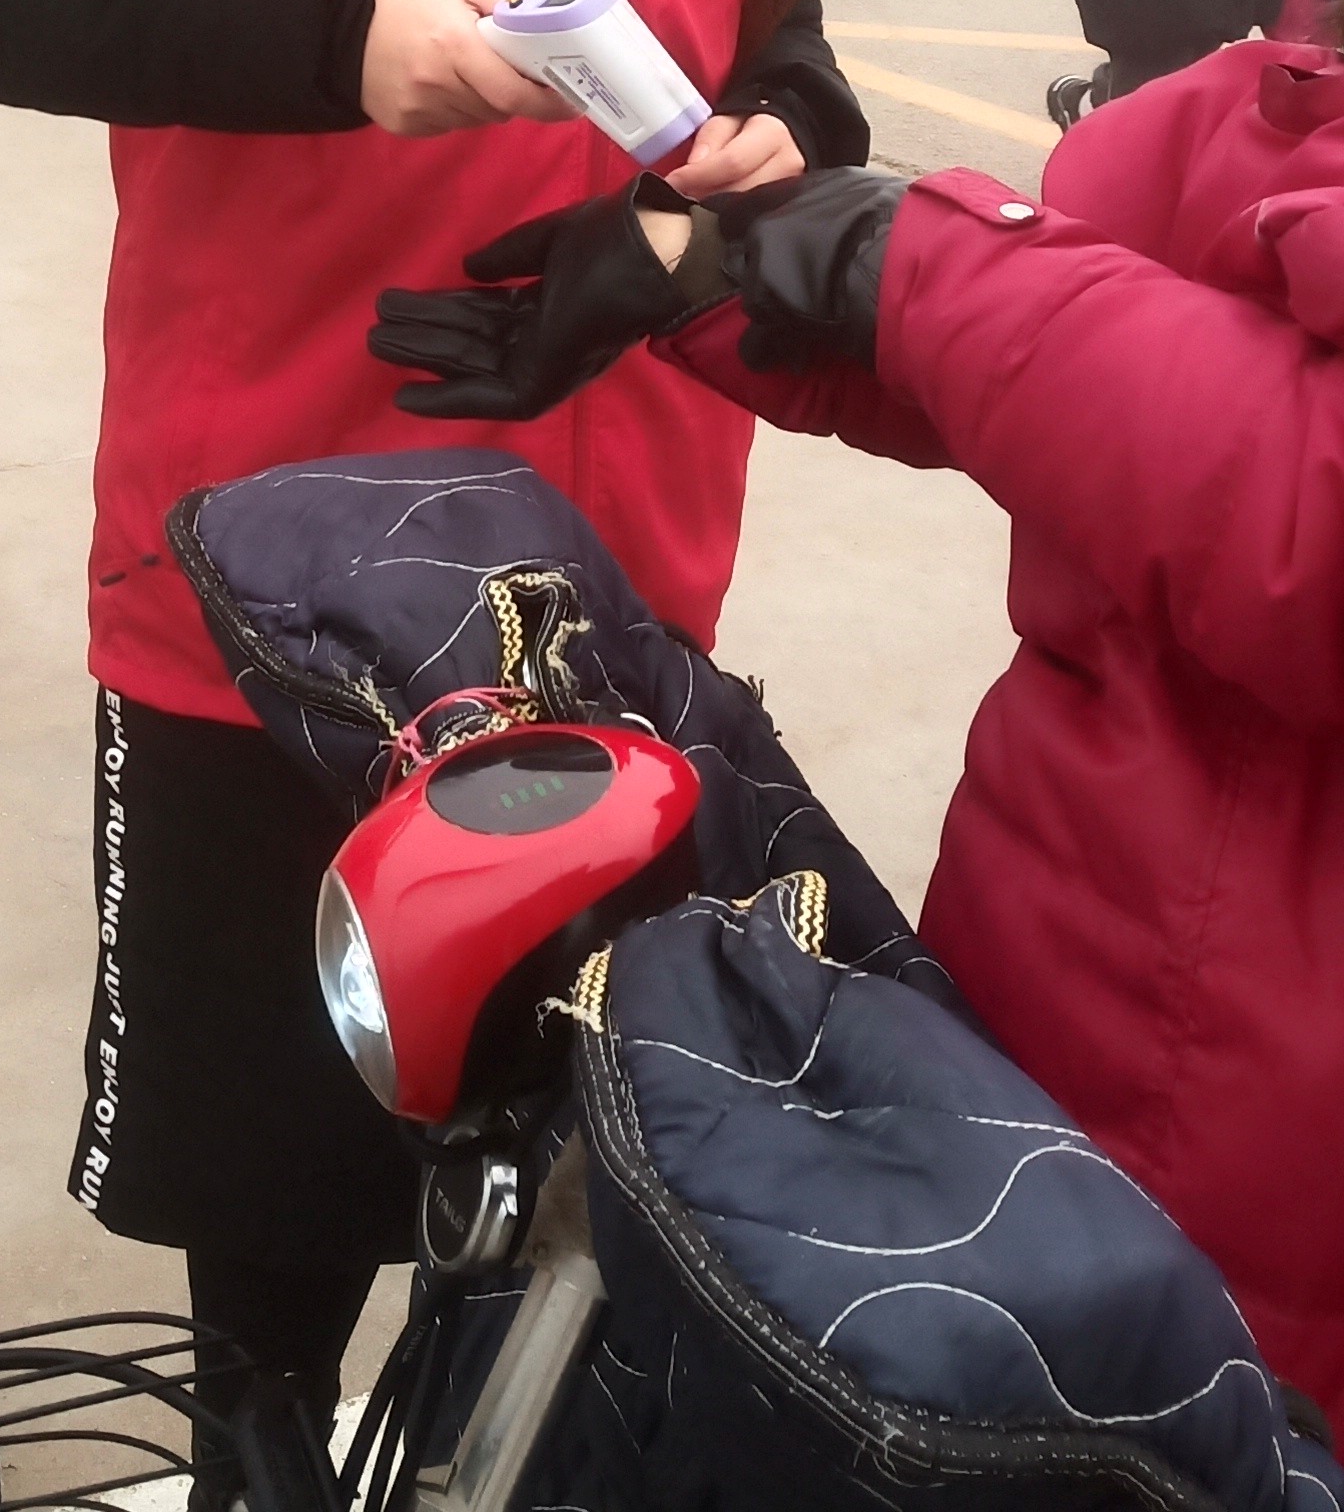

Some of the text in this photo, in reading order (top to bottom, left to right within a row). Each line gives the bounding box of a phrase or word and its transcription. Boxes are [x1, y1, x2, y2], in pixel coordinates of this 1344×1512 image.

[104, 688, 130, 795] ENJOY
[101, 798, 127, 948] RUNNING
[102, 952, 130, 1036] JUST
[93, 1038, 120, 1147] ENJOY
